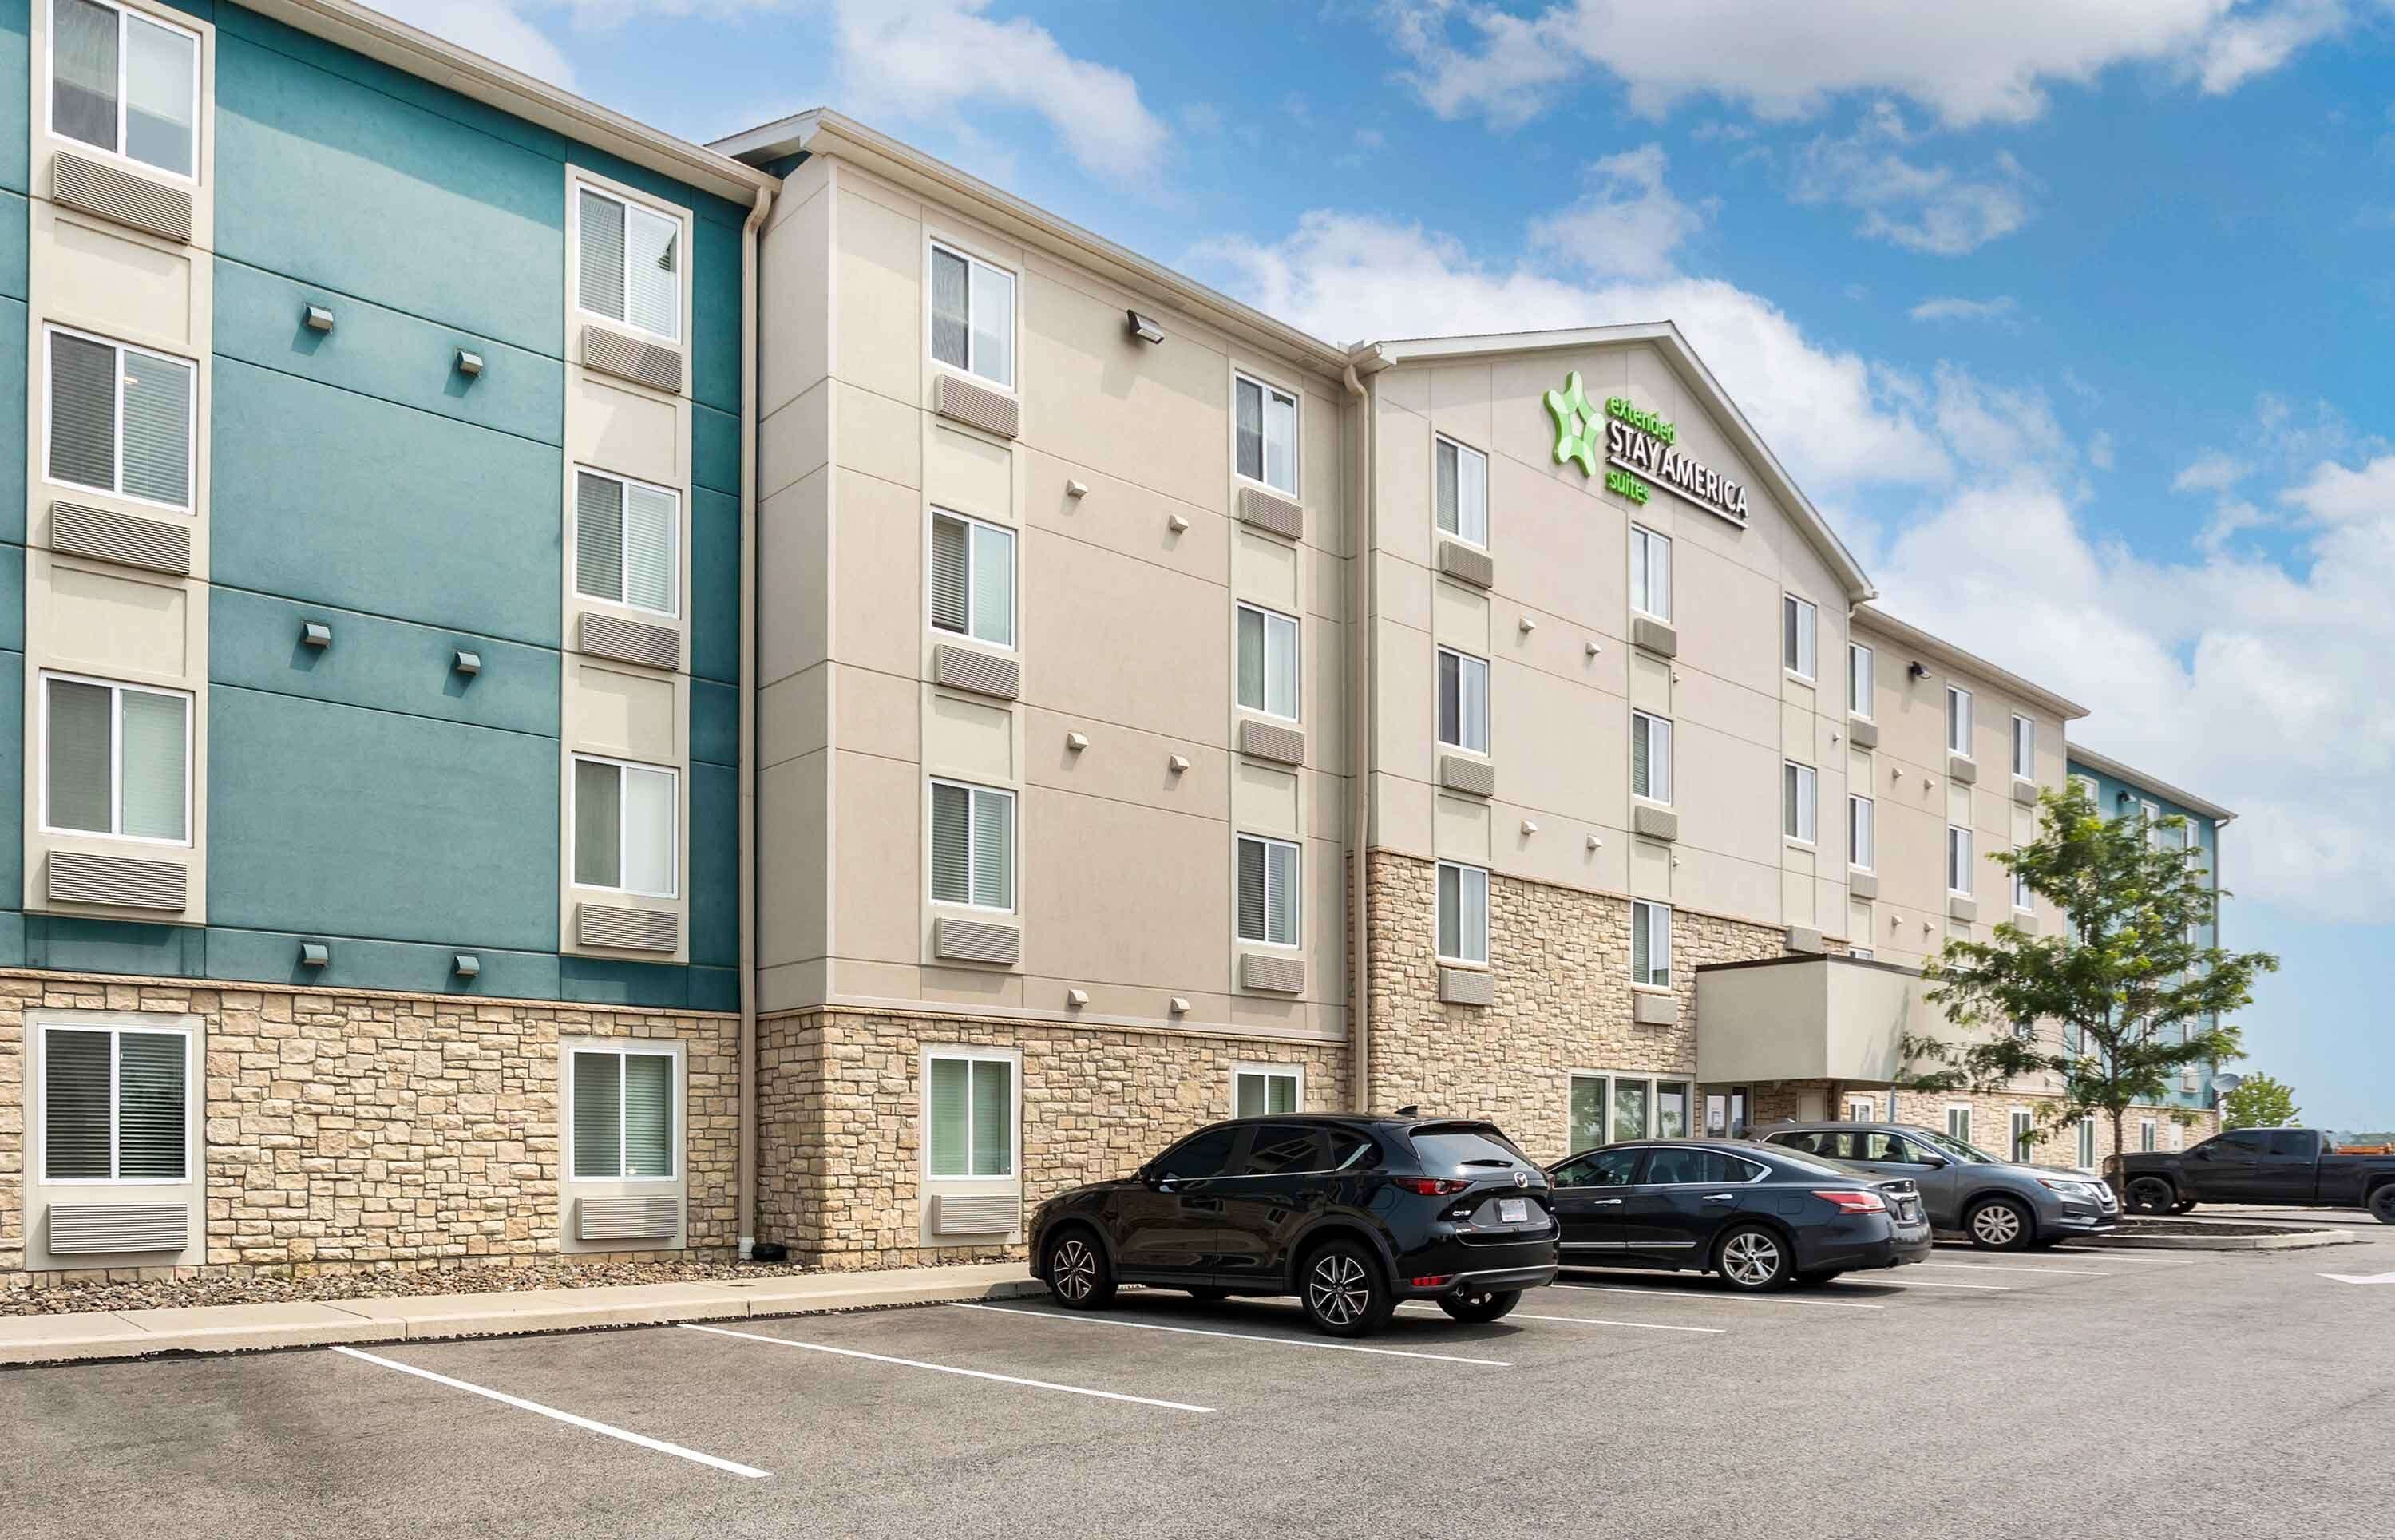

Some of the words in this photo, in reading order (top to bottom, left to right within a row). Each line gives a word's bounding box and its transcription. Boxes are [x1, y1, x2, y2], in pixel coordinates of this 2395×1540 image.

[1607, 396, 1676, 445] extended
[1607, 471, 1649, 505] suites
[1609, 420, 1660, 469] STAY
[1661, 445, 1748, 517] AMERICA
